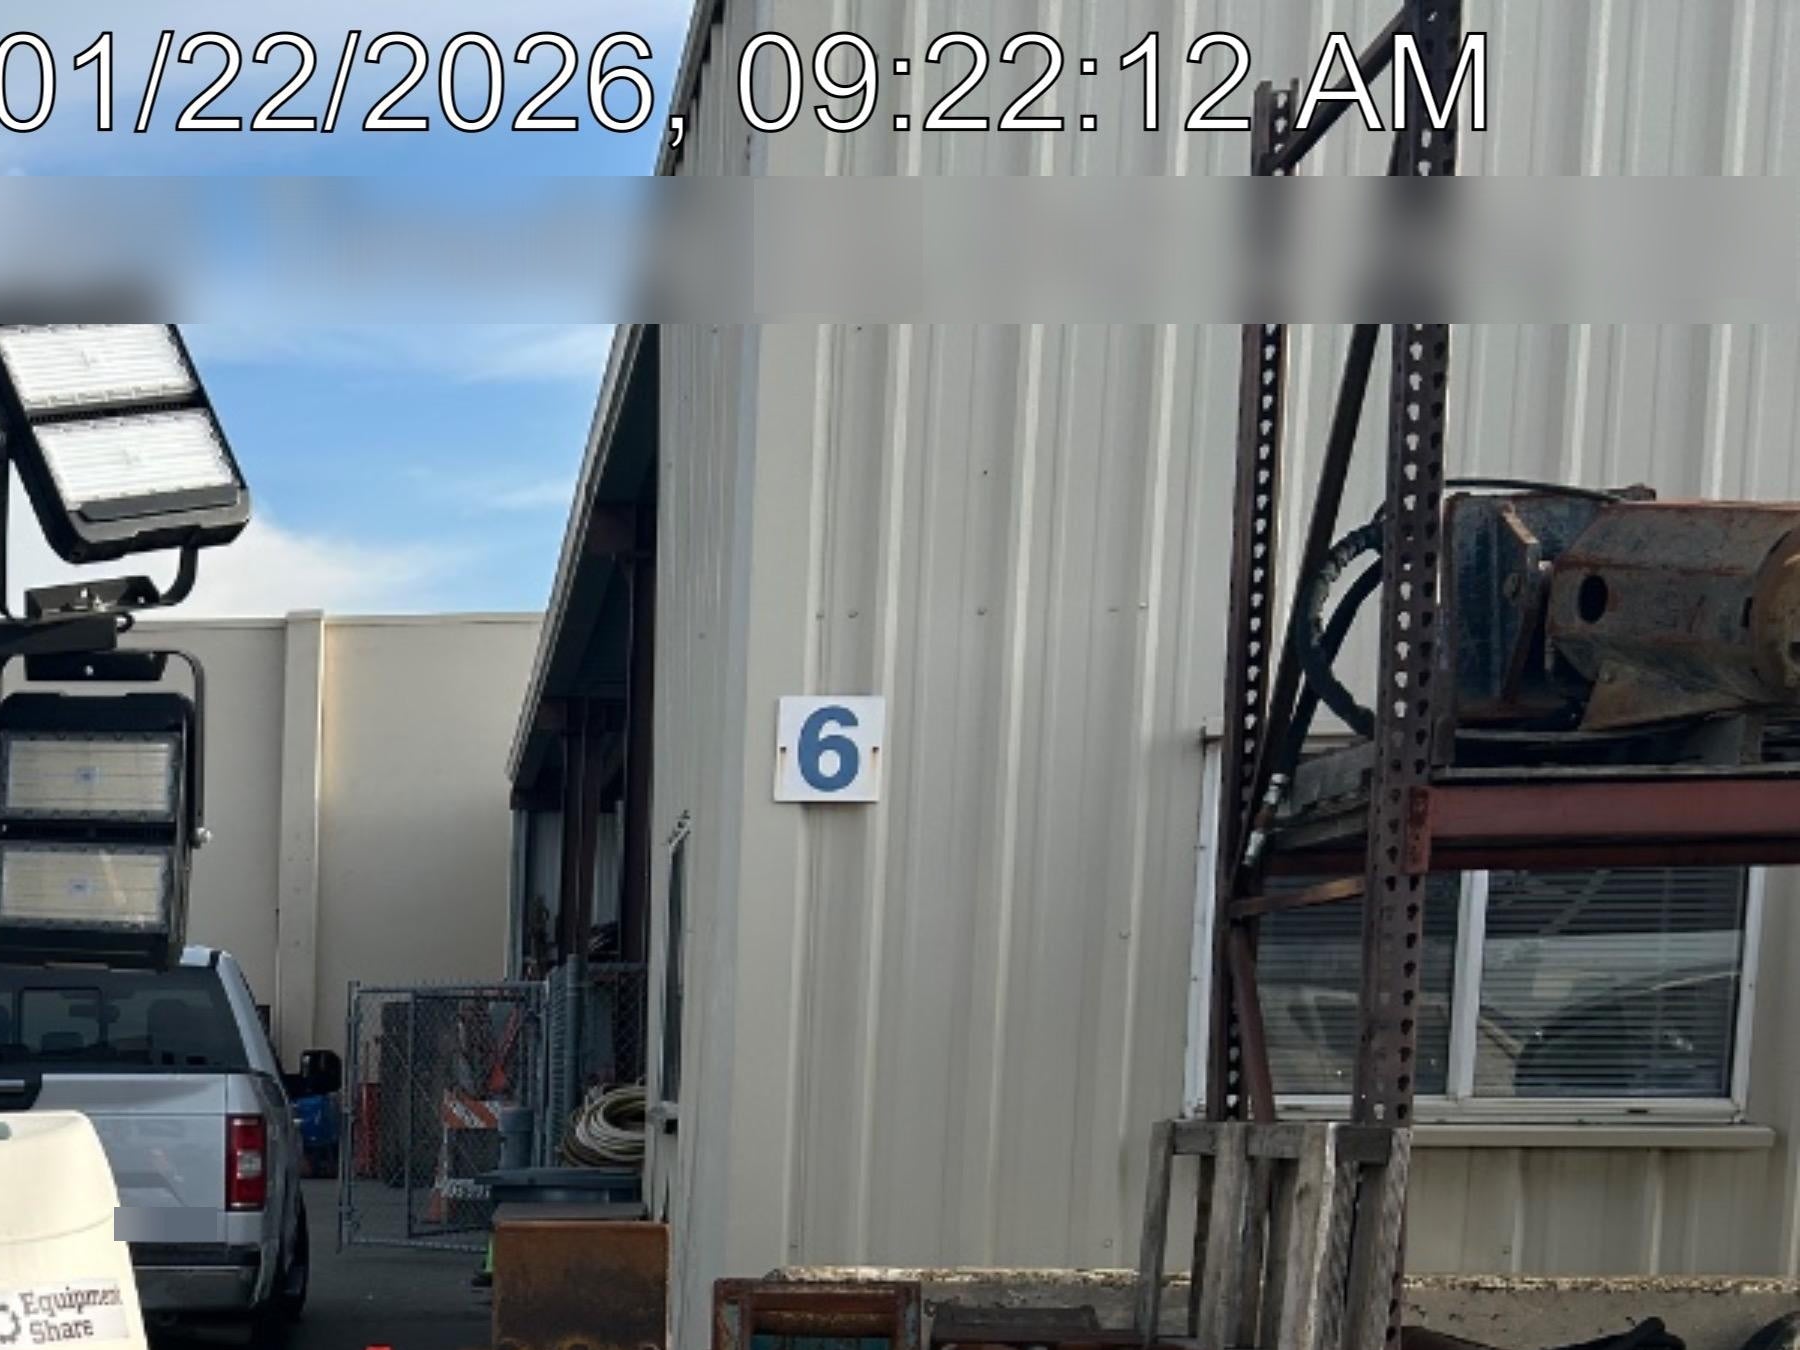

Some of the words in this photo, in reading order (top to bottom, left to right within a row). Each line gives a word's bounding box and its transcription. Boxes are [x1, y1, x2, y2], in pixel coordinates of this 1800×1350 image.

[797, 704, 860, 793] 6
[17, 1284, 124, 1317] Equipment
[28, 1318, 94, 1345] Share
